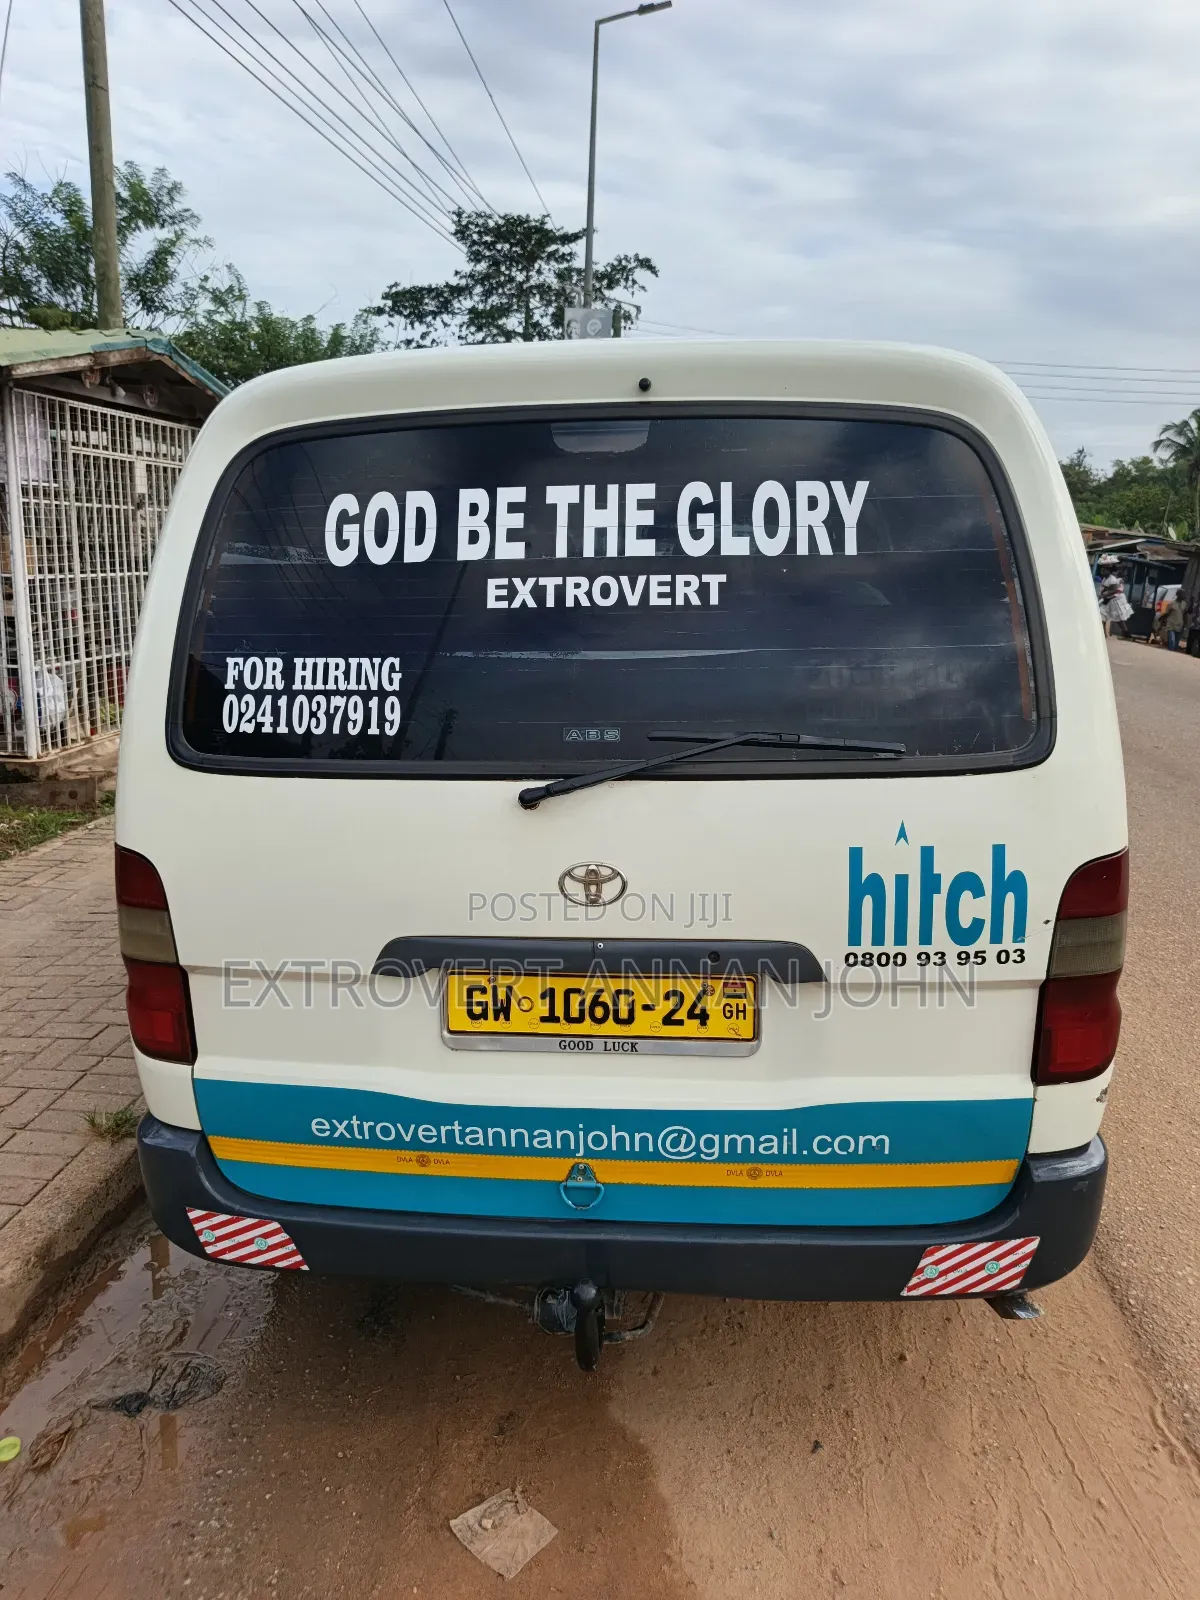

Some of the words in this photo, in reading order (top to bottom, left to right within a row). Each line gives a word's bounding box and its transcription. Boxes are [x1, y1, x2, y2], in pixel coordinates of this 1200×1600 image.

[324, 490, 437, 567] GOD
[457, 486, 526, 561] BE
[545, 483, 656, 558] THE
[676, 480, 870, 557] GLORY
[486, 574, 727, 609] EXTROVERT
[224, 656, 284, 691] FOR
[292, 656, 402, 692] HIRING
[222, 694, 401, 736] 0241037919
[565, 729, 619, 741] ABS
[847, 820, 1028, 947] hitch
[844, 952, 907, 967] 0800
[916, 951, 947, 967] 93
[956, 950, 987, 966] 95
[996, 948, 1026, 965] 03
[466, 985, 512, 1021] GW
[538, 986, 710, 1026] 1060-24
[722, 1002, 747, 1020] GH
[558, 1039, 594, 1051] GOOD
[603, 1040, 639, 1053] LUCK
[310, 1115, 891, 1161] extrovertannanjohn@gmail.com
[726, 1169, 744, 1177] DVLA
